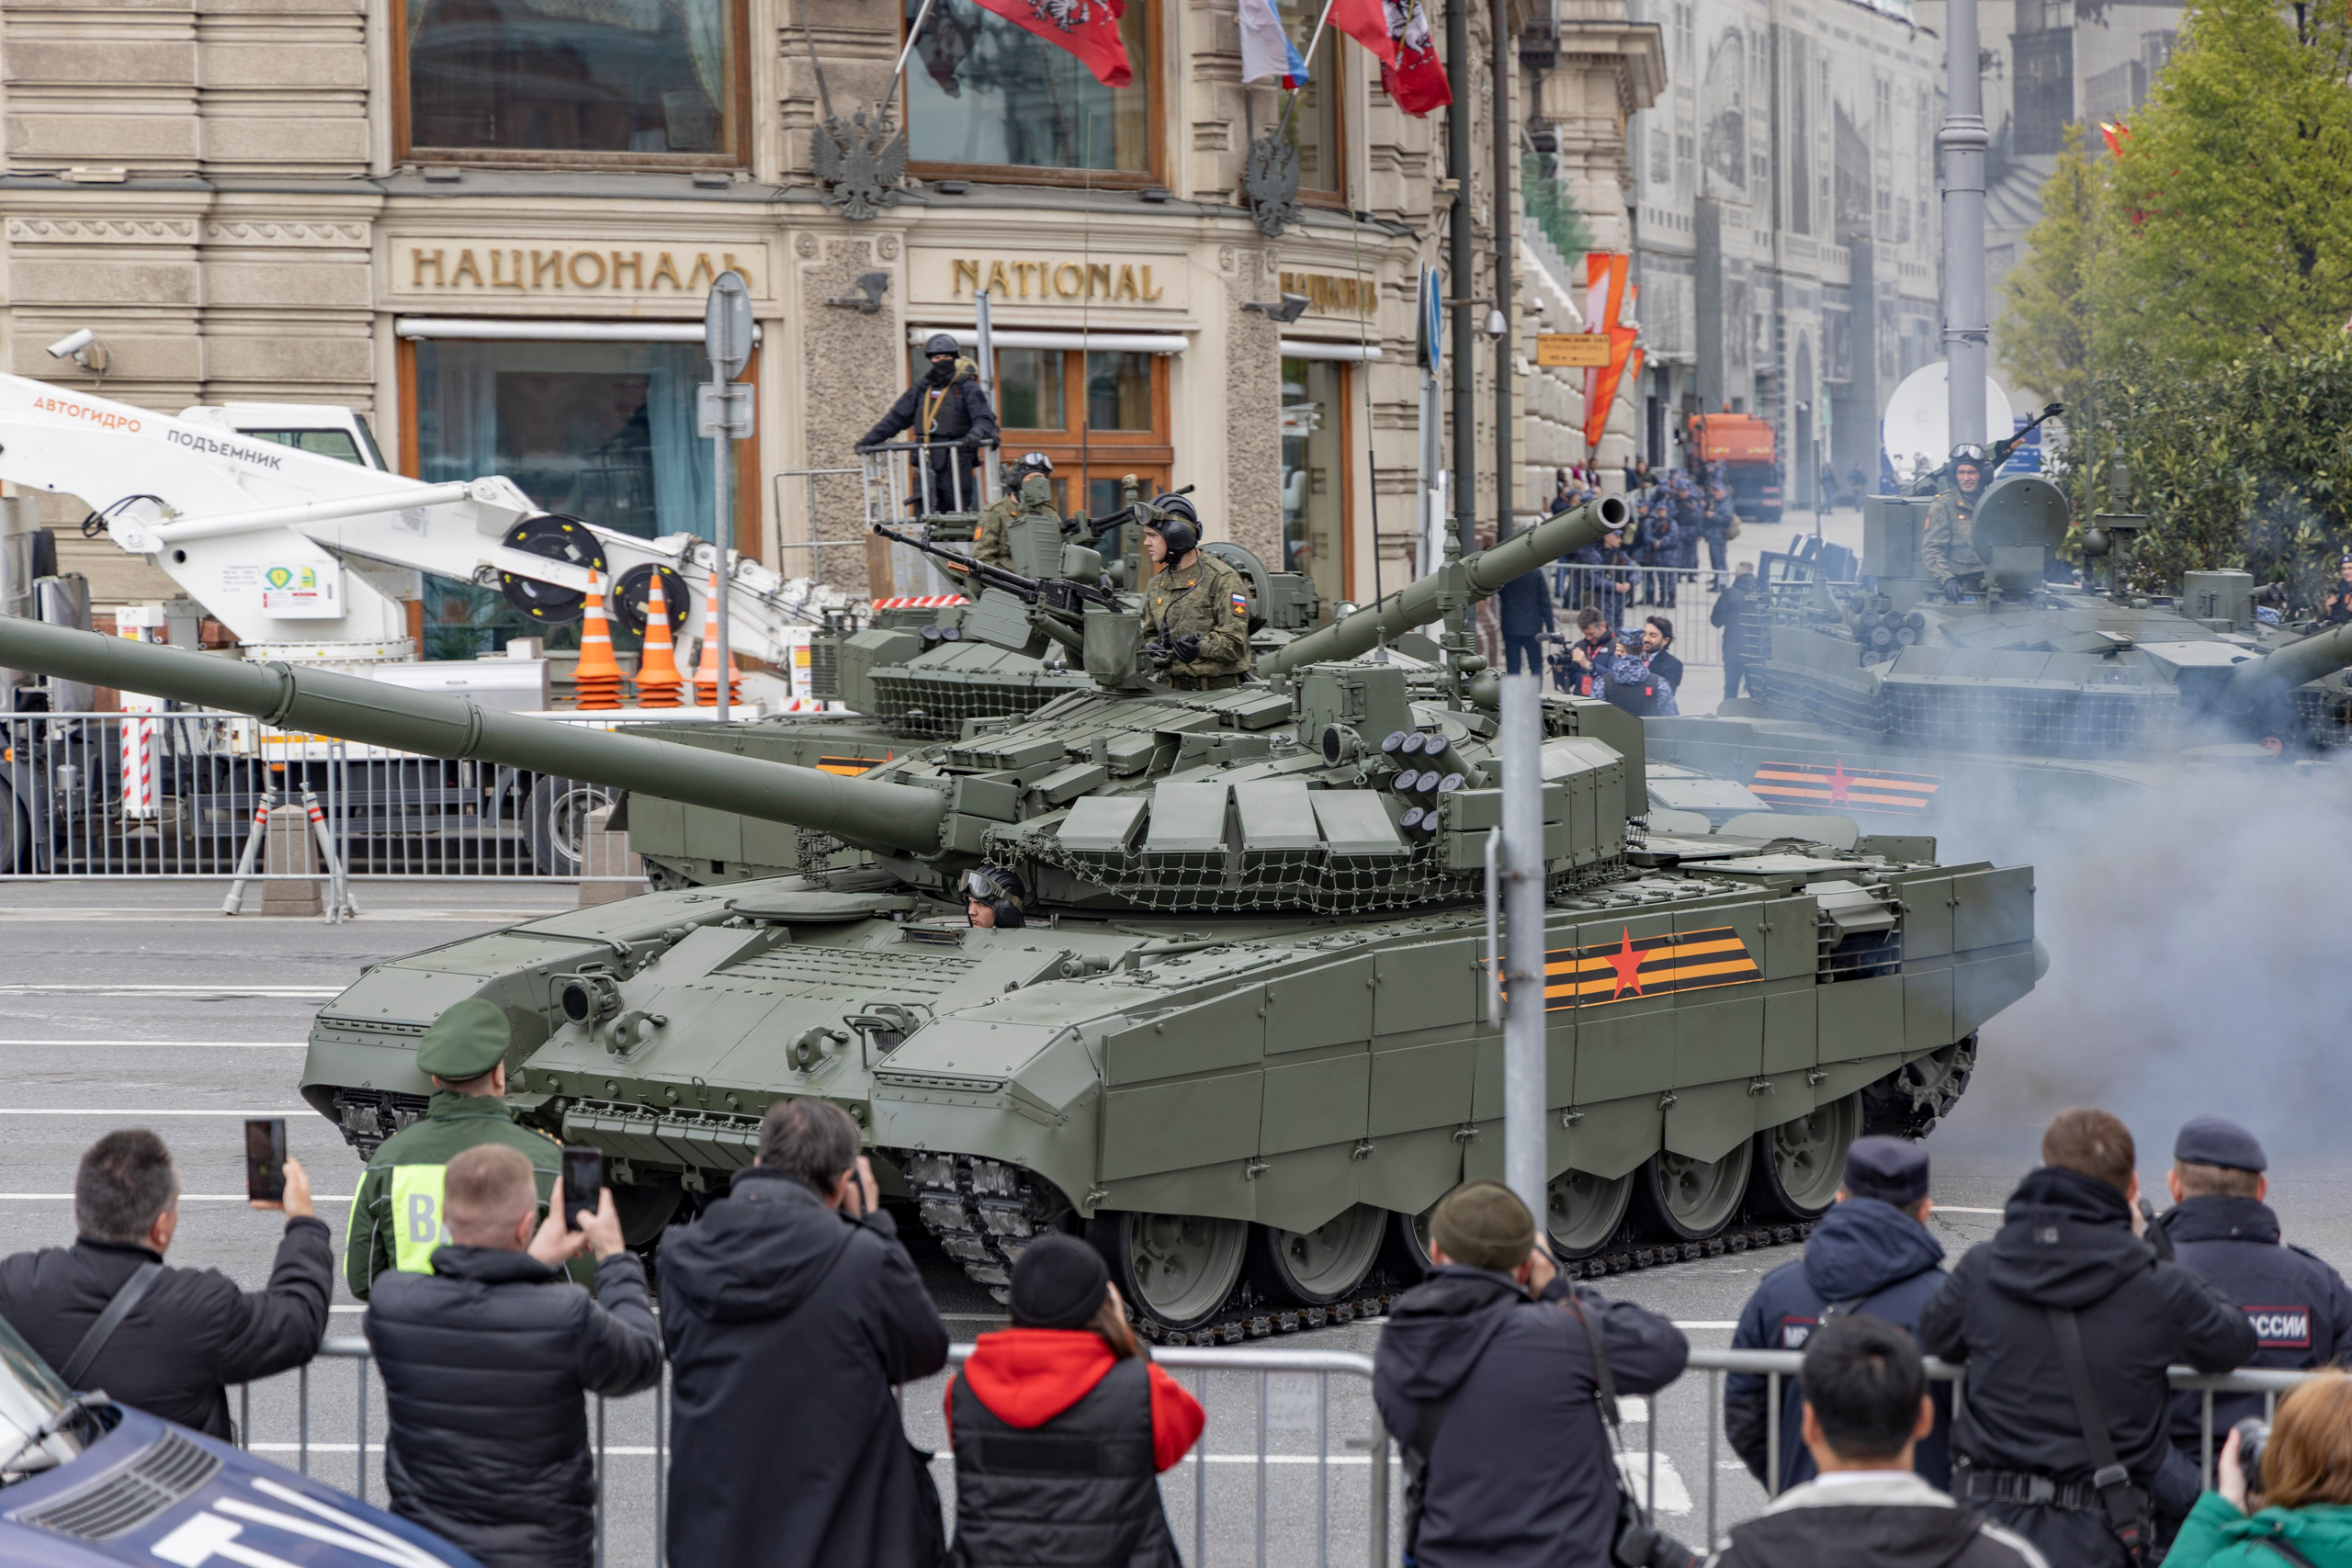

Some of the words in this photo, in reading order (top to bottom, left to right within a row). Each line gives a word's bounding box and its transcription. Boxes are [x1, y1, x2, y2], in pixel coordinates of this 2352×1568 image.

[952, 258, 1164, 301] NATIONAL
[33, 396, 142, 434] АВТОГИДРО
[167, 429, 283, 471] ПОДЪЕМНИК
